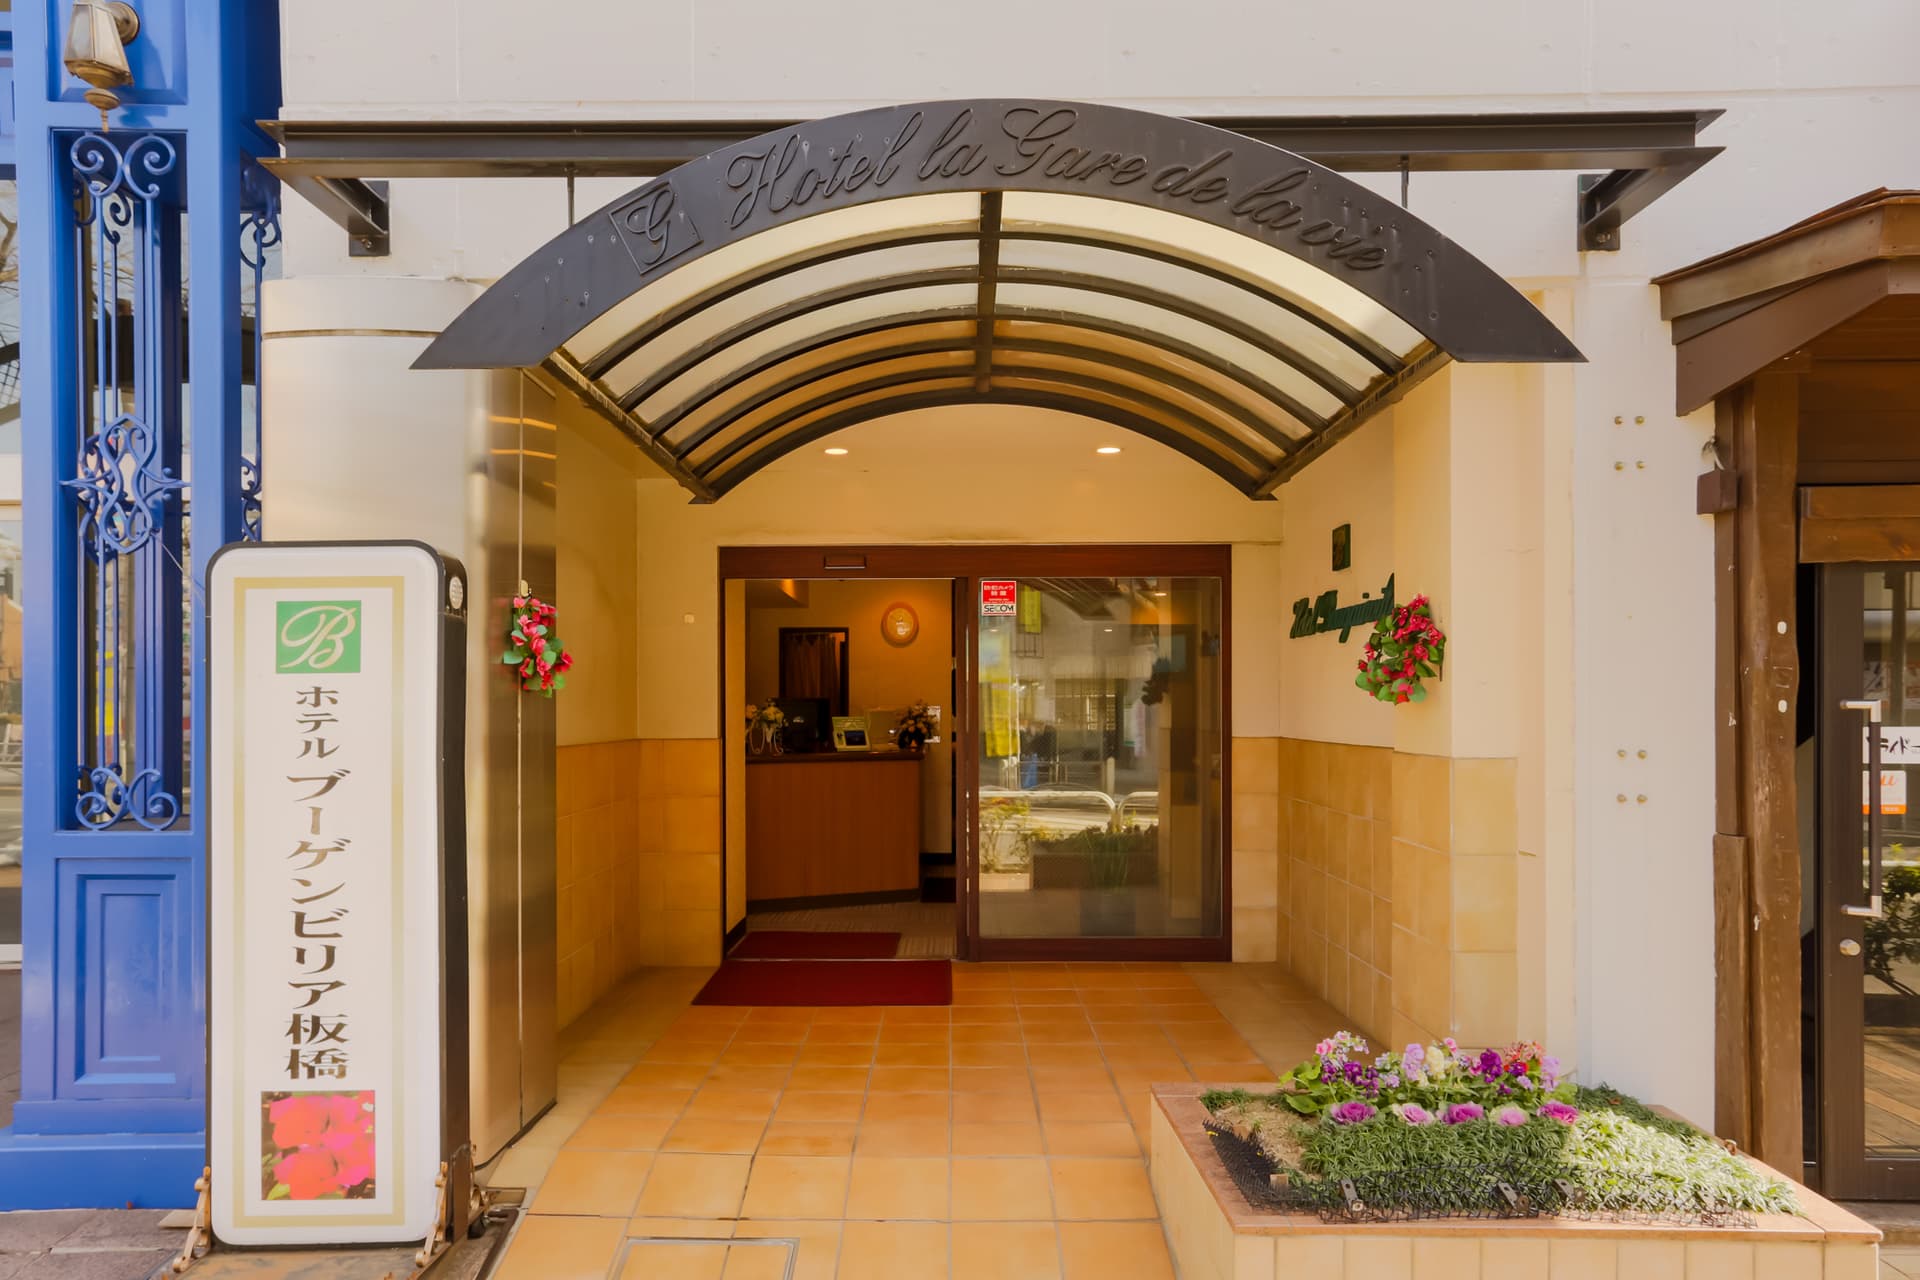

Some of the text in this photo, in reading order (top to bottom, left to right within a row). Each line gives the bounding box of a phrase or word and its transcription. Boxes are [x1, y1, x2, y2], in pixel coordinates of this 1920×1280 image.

[726, 107, 1387, 271] Hotel la Gare de la vie
[280, 605, 357, 669] B
[983, 604, 1014, 613] SECOM
